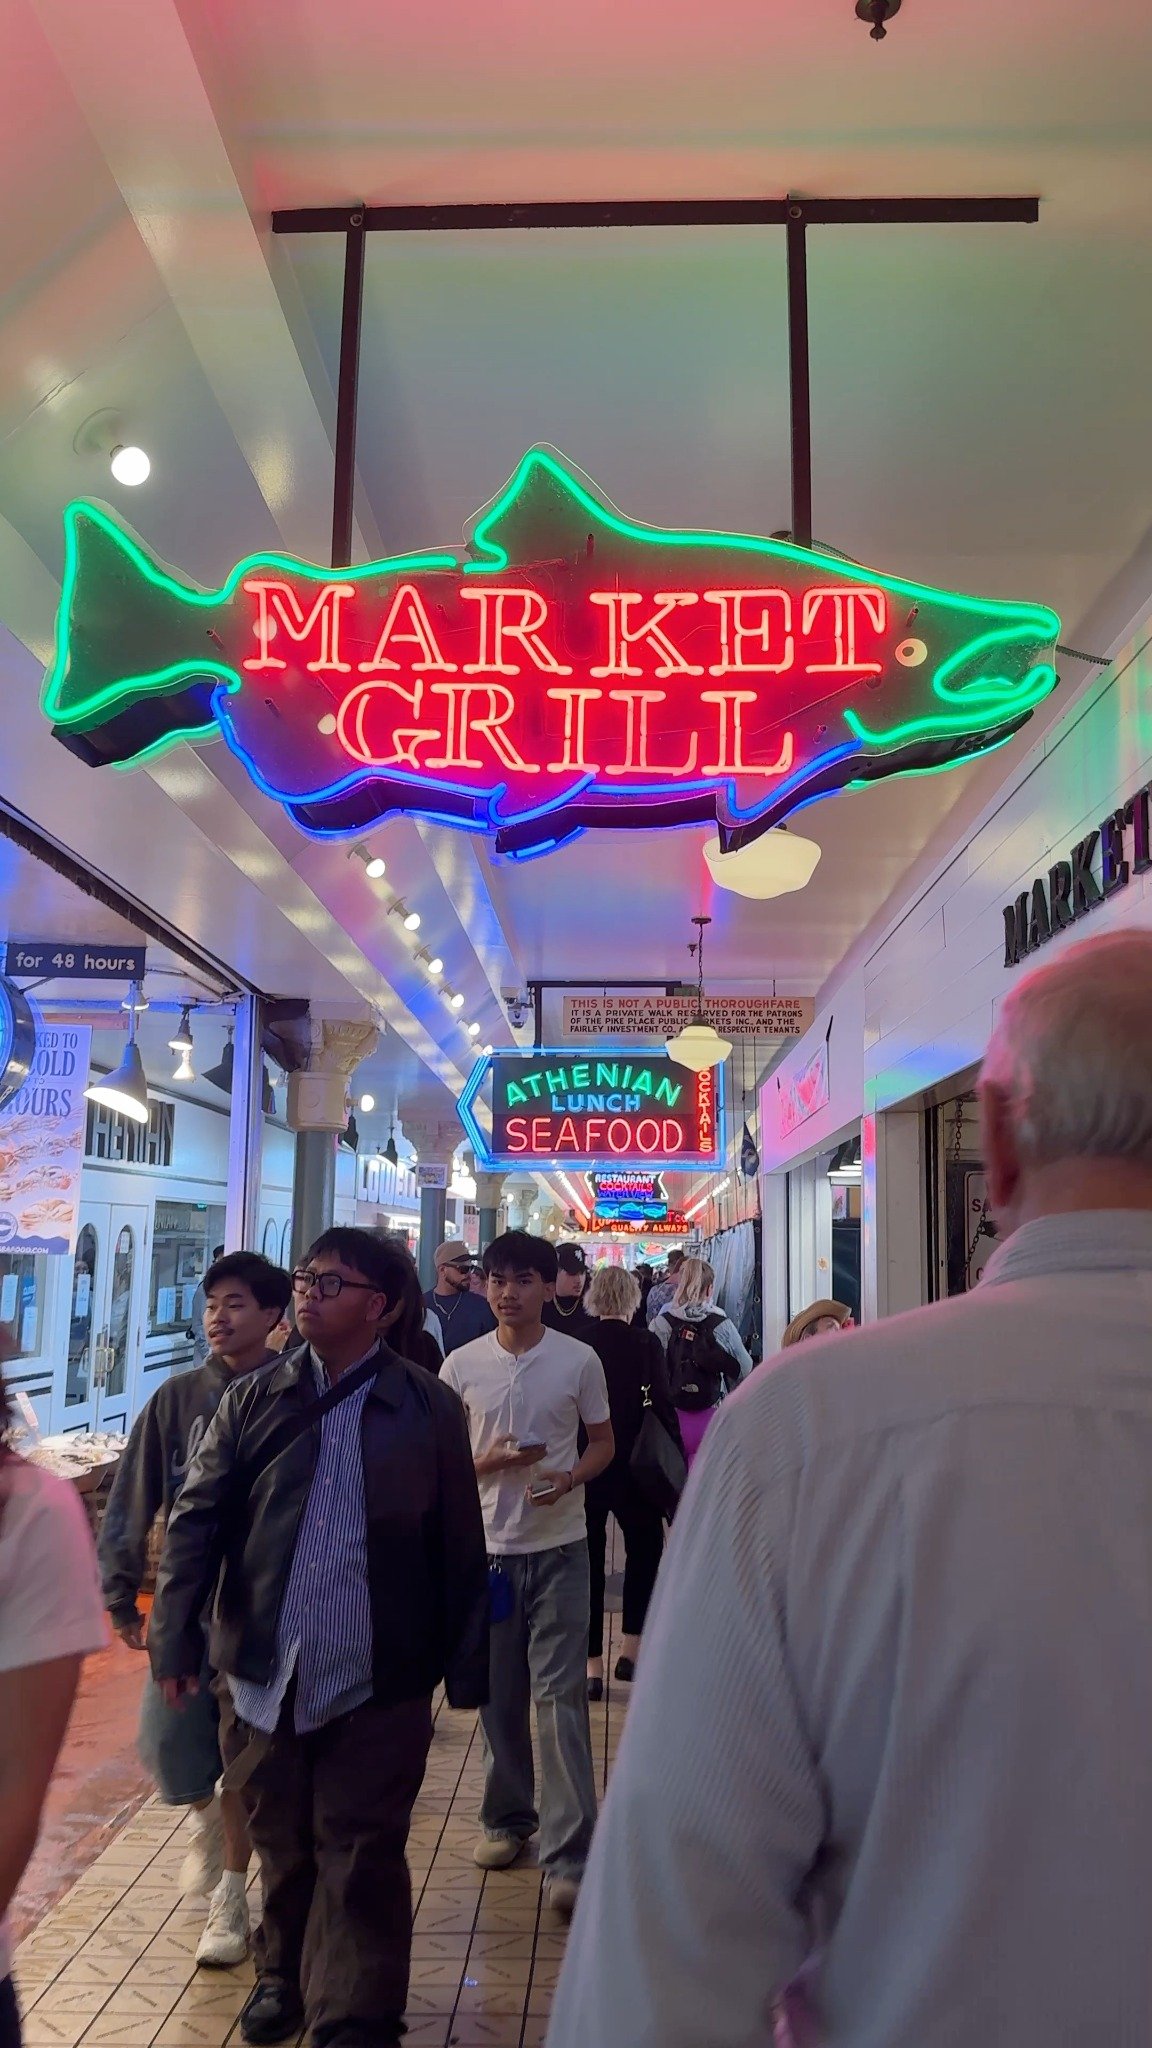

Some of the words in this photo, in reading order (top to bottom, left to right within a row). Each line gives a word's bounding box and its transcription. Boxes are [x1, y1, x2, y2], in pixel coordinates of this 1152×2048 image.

[242, 580, 887, 678] MARKET
[336, 680, 794, 775] GRILL
[1002, 780, 1152, 968] MARKET
[16, 952, 43, 968] for
[52, 953, 75, 968] 48
[84, 954, 136, 971] hours
[571, 999, 598, 1009] THIS
[603, 999, 613, 1009] IS
[618, 999, 639, 1009] NOT
[644, 999, 652, 1009] A
[657, 999, 698, 1009] PUBLIC
[705, 999, 800, 1009] THOROUGHFARE
[571, 1009, 579, 1017] IT
[583, 1009, 591, 1017] IS
[595, 1009, 601, 1017] A
[606, 1009, 644, 1017] PRIVATE
[648, 1009, 672, 1017] WALK
[677, 1009, 728, 1017] RESRVED
[731, 1009, 746, 1017] FOR
[749, 1009, 764, 1017] THE
[766, 1009, 803, 1017] PATRONS
[63, 1033, 78, 1049] TO
[36, 1050, 76, 1076] OLD
[506, 1062, 683, 1108] ATHENIAN
[13, 1087, 72, 1117] OURS
[551, 1094, 641, 1112] LUNCH
[698, 1070, 713, 1152] OCKTAILS
[506, 1117, 683, 1152] SEAFOOD
[595, 1173, 656, 1183] RESTAURANT
[599, 1182, 653, 1192] COCKTAILS
[652, 1224, 688, 1233] ALWAYS
